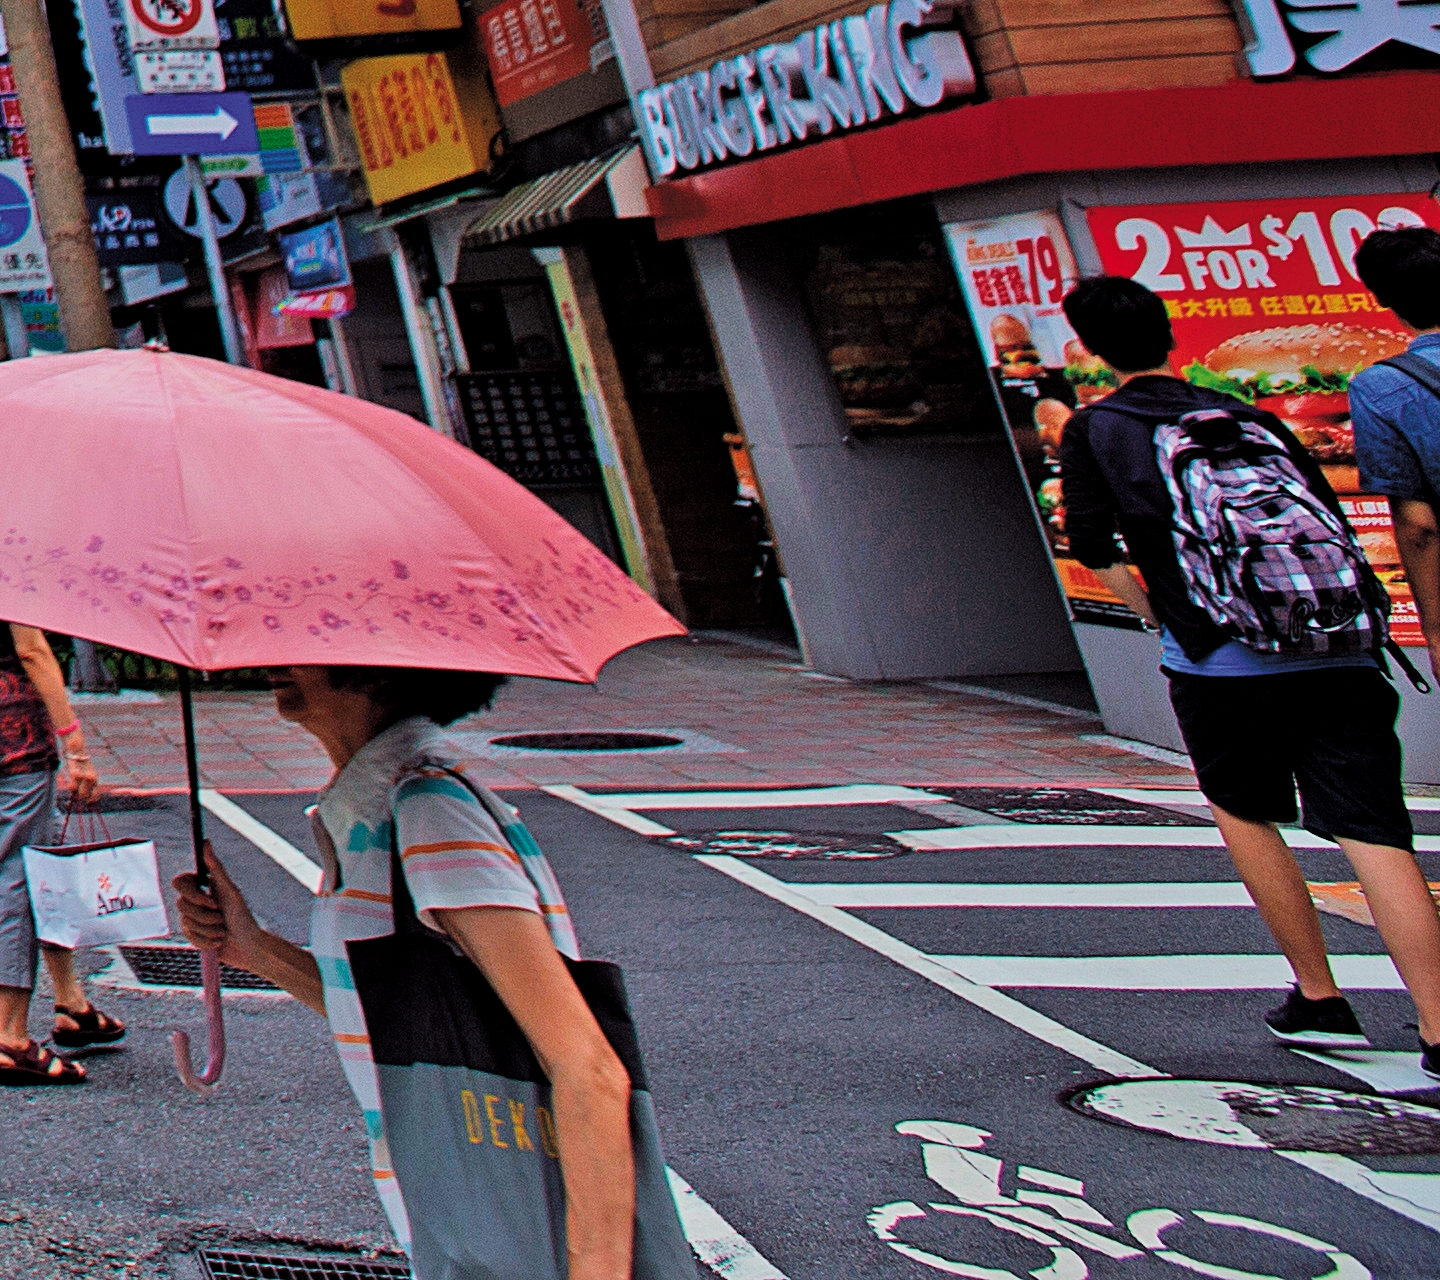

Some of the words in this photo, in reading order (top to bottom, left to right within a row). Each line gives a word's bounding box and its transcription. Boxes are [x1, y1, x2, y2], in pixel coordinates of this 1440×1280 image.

[639, 40, 808, 178] BURGER
[1016, 235, 1062, 306] 79
[1115, 218, 1185, 293] 2
[1182, 249, 1277, 292] FOR
[1261, 292, 1393, 316] 任選2堡只
